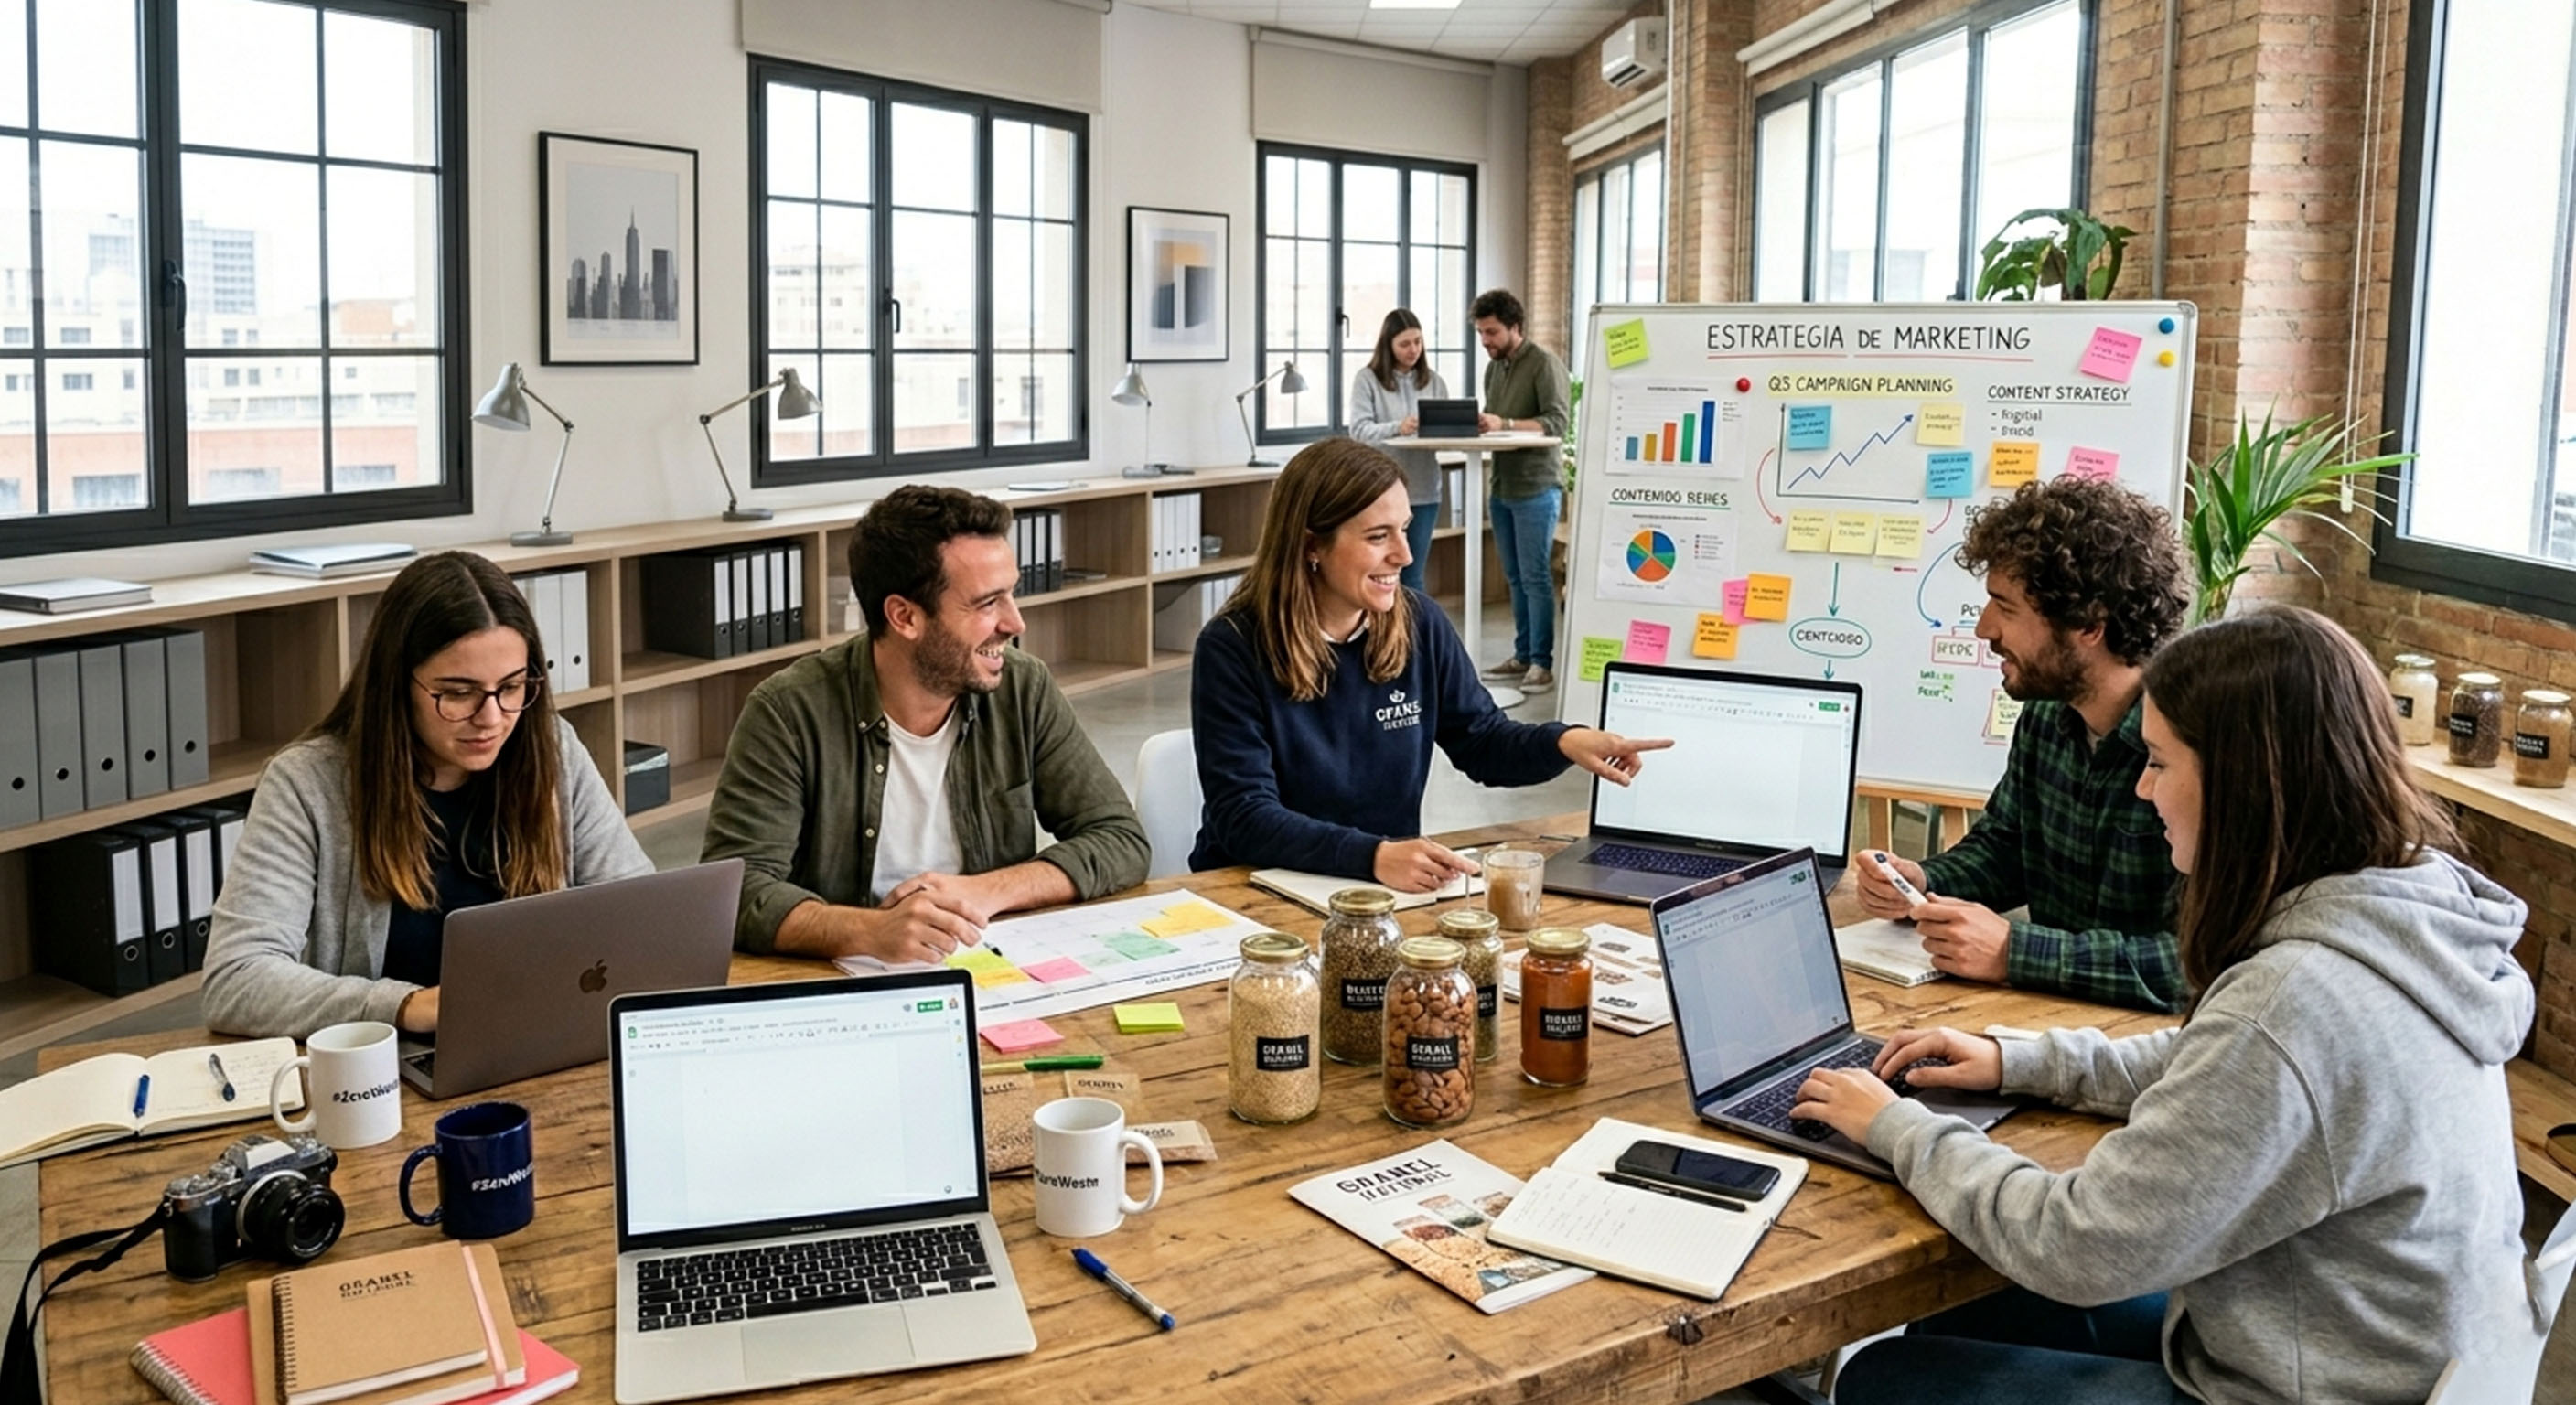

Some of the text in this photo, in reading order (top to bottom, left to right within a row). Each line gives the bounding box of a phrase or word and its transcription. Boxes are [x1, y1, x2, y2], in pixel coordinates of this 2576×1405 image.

[1706, 324, 2032, 349] ESTRATEGIA DE MARKETING
[1877, 377, 1954, 393] PLANNING
[1988, 385, 2131, 401] CONTENT STRATEGY
[1611, 488, 1682, 504] CONTENIDO
